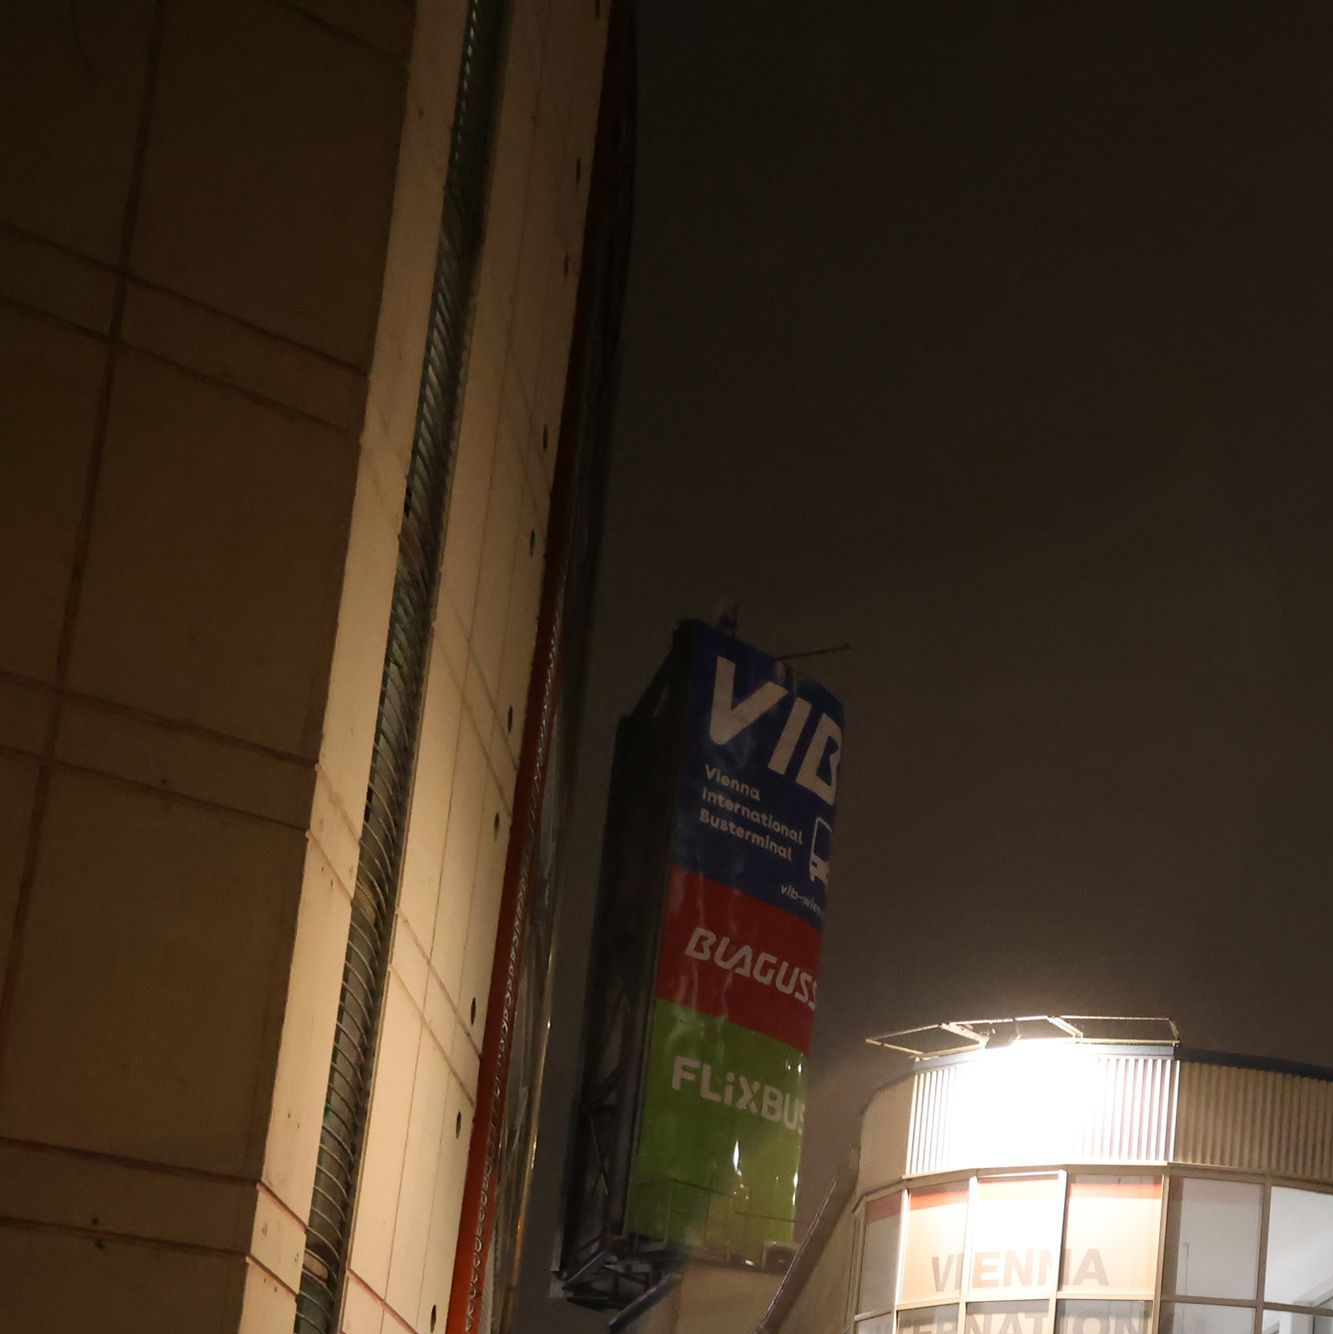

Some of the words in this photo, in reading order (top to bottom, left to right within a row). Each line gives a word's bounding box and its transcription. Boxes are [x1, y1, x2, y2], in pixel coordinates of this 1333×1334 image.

[709, 655, 843, 805] VIB
[705, 764, 761, 801] Vienna
[700, 808, 793, 862] Busterminal
[702, 786, 804, 845] International
[931, 1248, 1110, 1293] VIENNA
